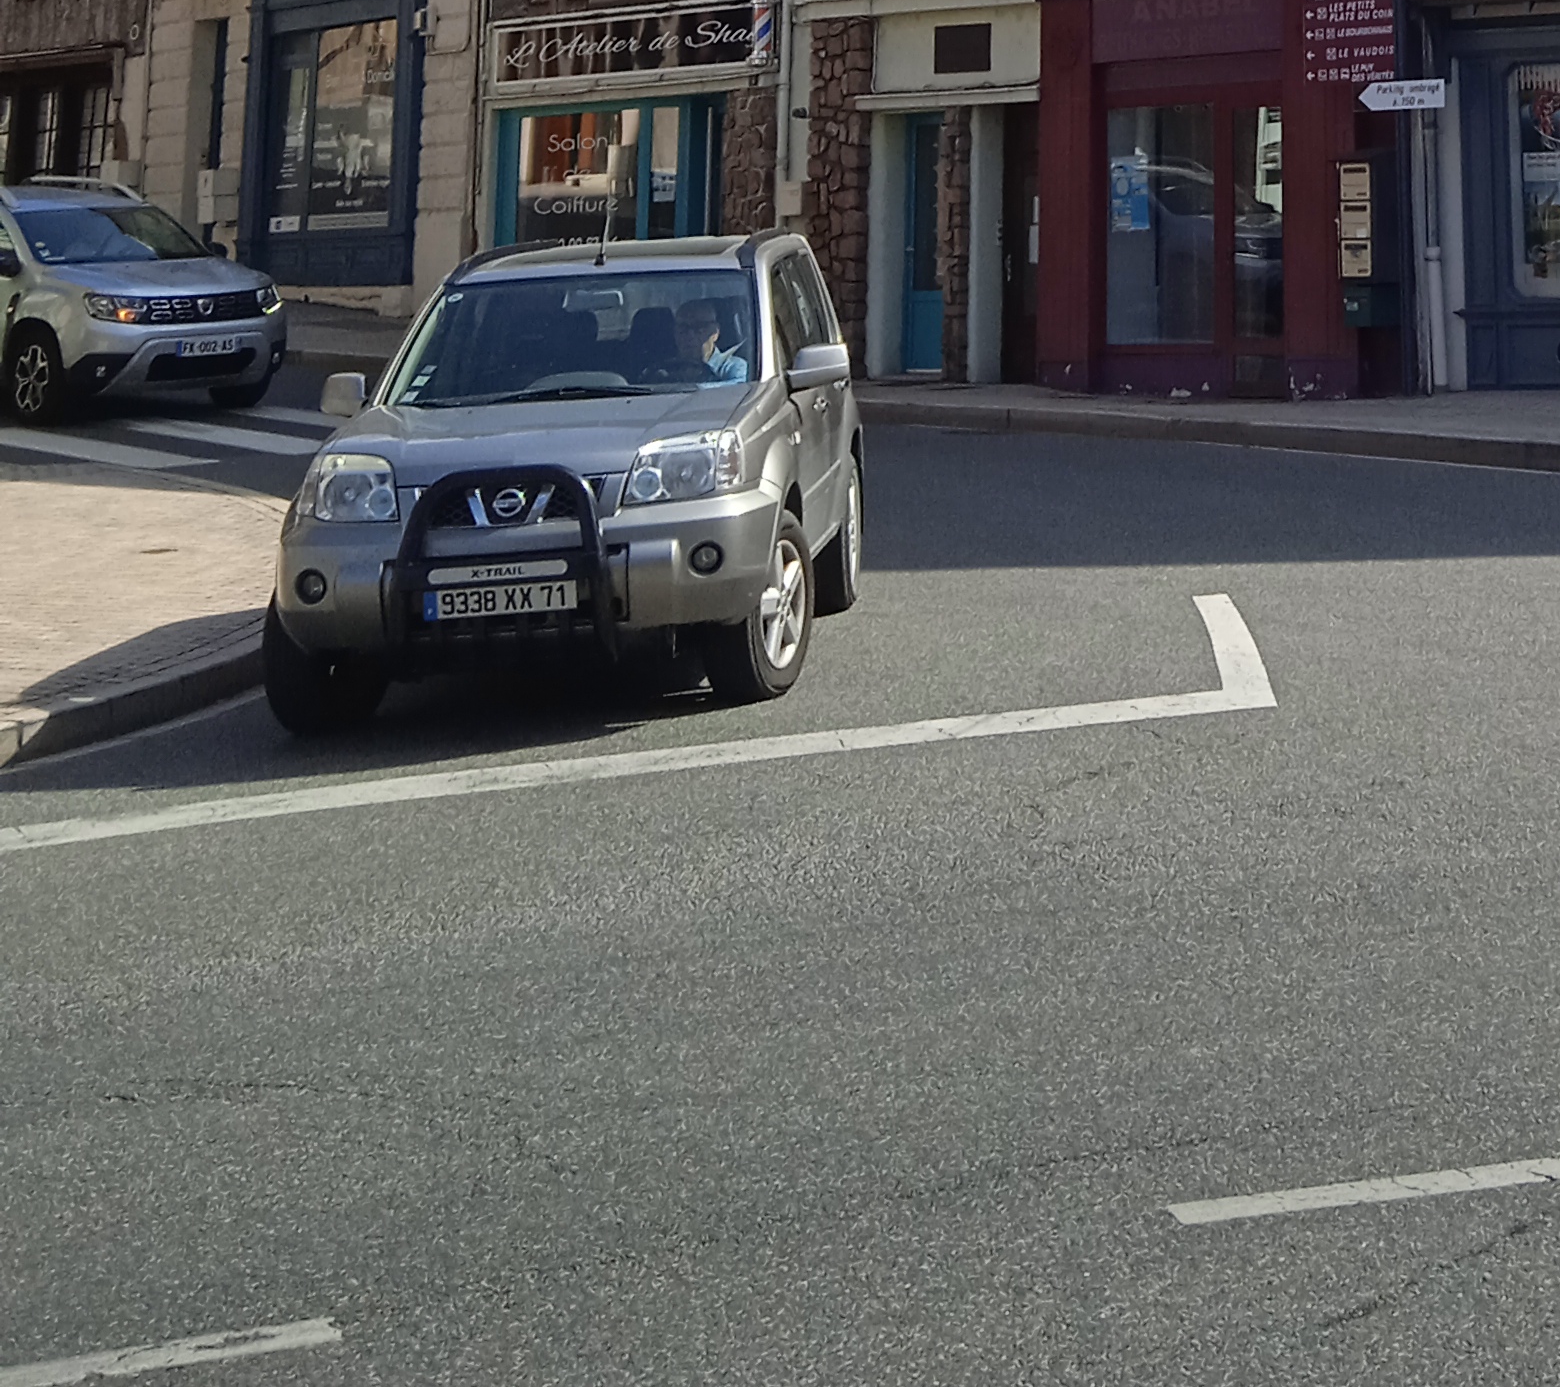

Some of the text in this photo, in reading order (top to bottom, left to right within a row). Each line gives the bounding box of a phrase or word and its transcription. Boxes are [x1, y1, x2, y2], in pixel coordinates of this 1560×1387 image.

[1329, 0, 1376, 12] LES PETITS
[1329, 12, 1356, 23] PLATS
[1357, 11, 1371, 20] DU
[648, 31, 680, 52] de
[1338, 45, 1394, 58] LE VAUDOIS
[1377, 84, 1405, 97] Parking
[548, 133, 608, 153] Salon
[534, 197, 619, 216] Coiffure
[471, 565, 526, 579] X-TRAIL
[442, 584, 566, 615] 9338 XX 71
